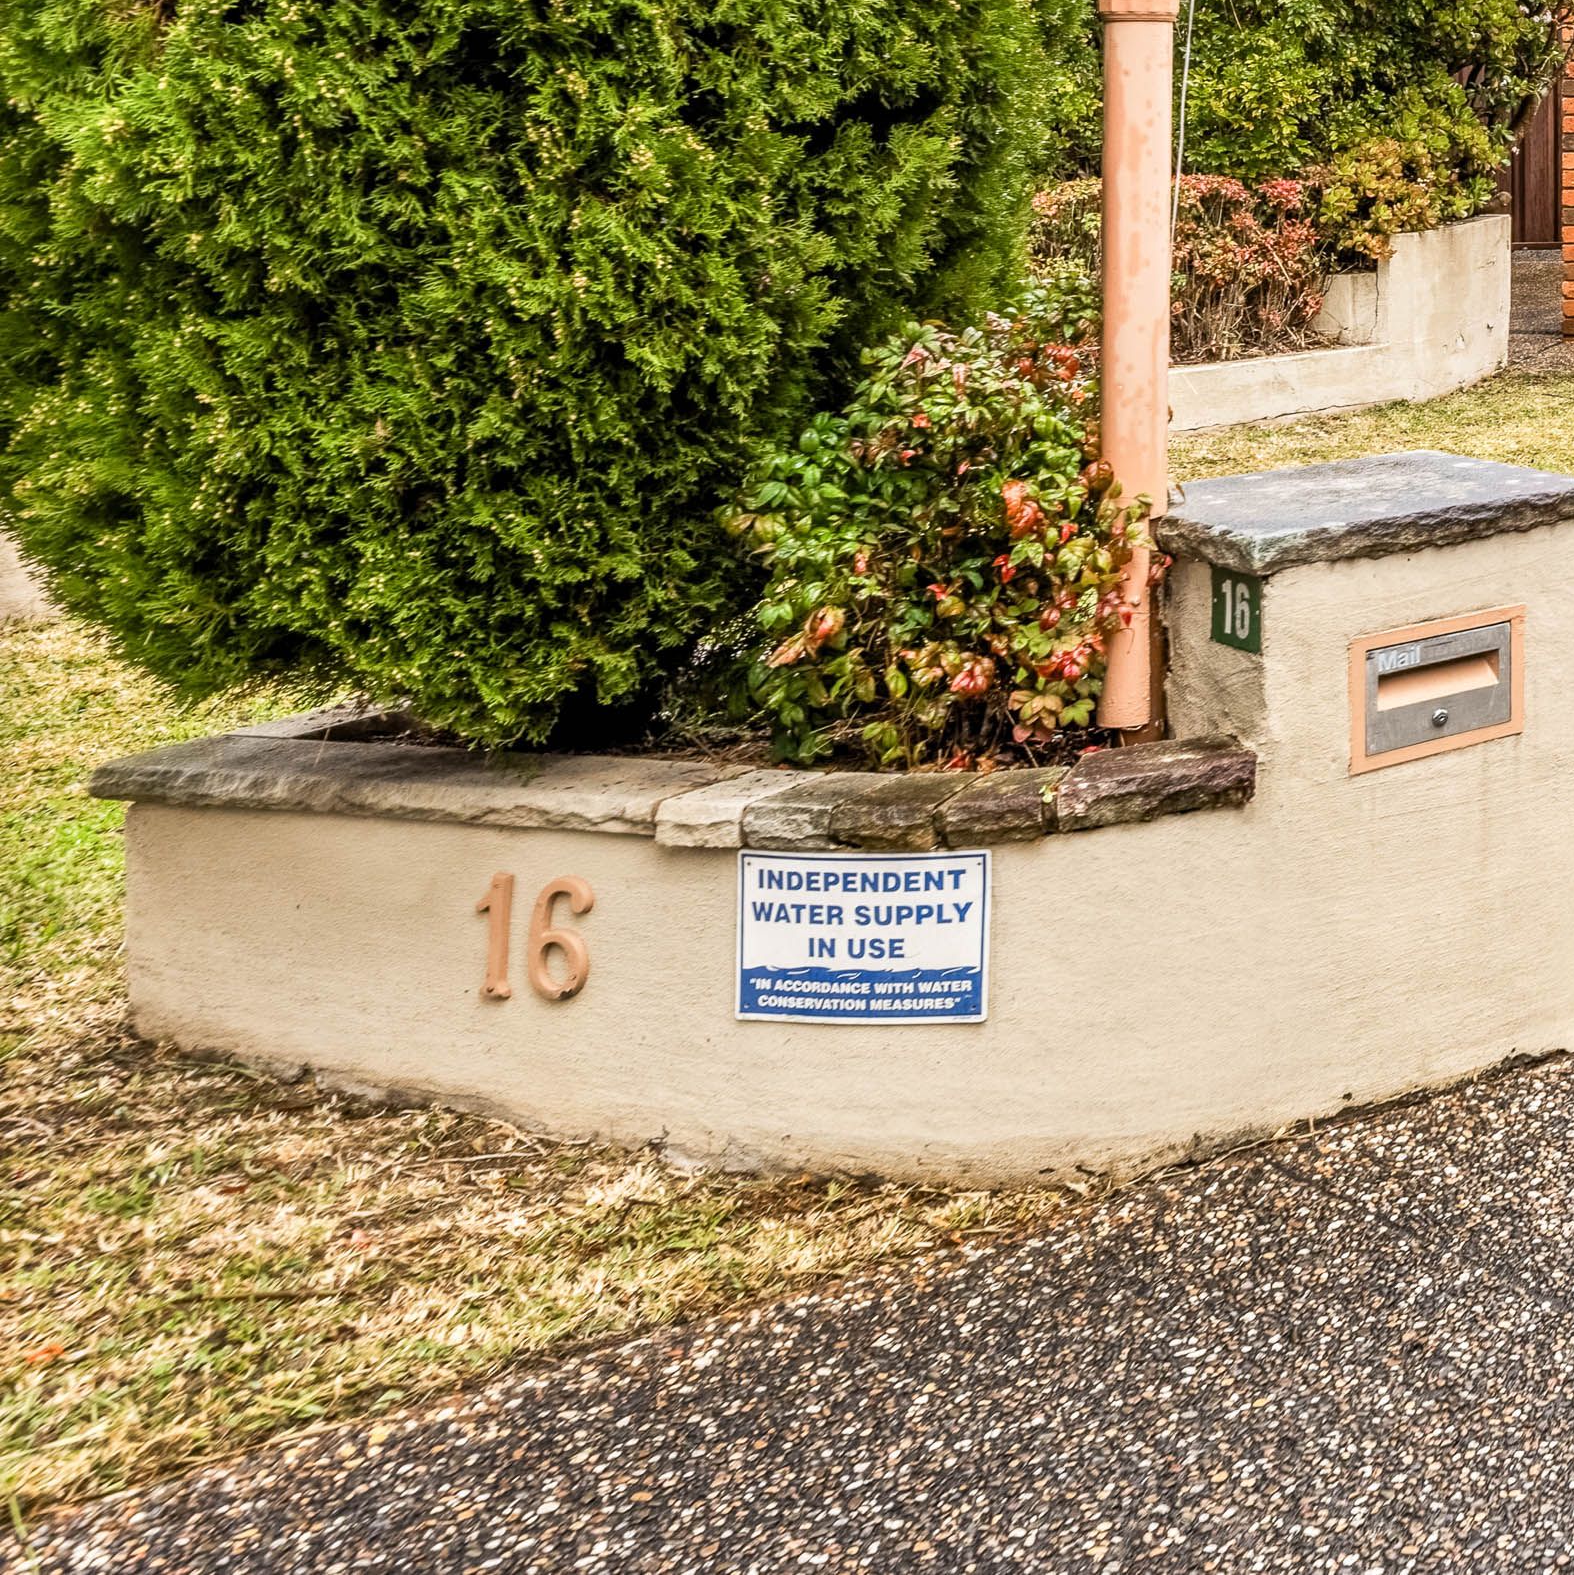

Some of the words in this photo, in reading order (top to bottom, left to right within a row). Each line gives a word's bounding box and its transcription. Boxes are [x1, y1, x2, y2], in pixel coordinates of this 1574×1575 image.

[1222, 579, 1250, 639] 16
[1378, 645, 1421, 671] Mail
[758, 868, 966, 893] INDEPENDENT
[752, 901, 843, 925] WATER
[854, 901, 974, 926] SUPPLY
[476, 872, 595, 1002] 16
[808, 937, 836, 958] IN
[847, 938, 905, 959] USE
[773, 978, 871, 995] ACCORDANCE
[873, 980, 914, 994] WITH
[918, 979, 973, 994] WATER
[757, 994, 867, 1011] CONSERVATION
